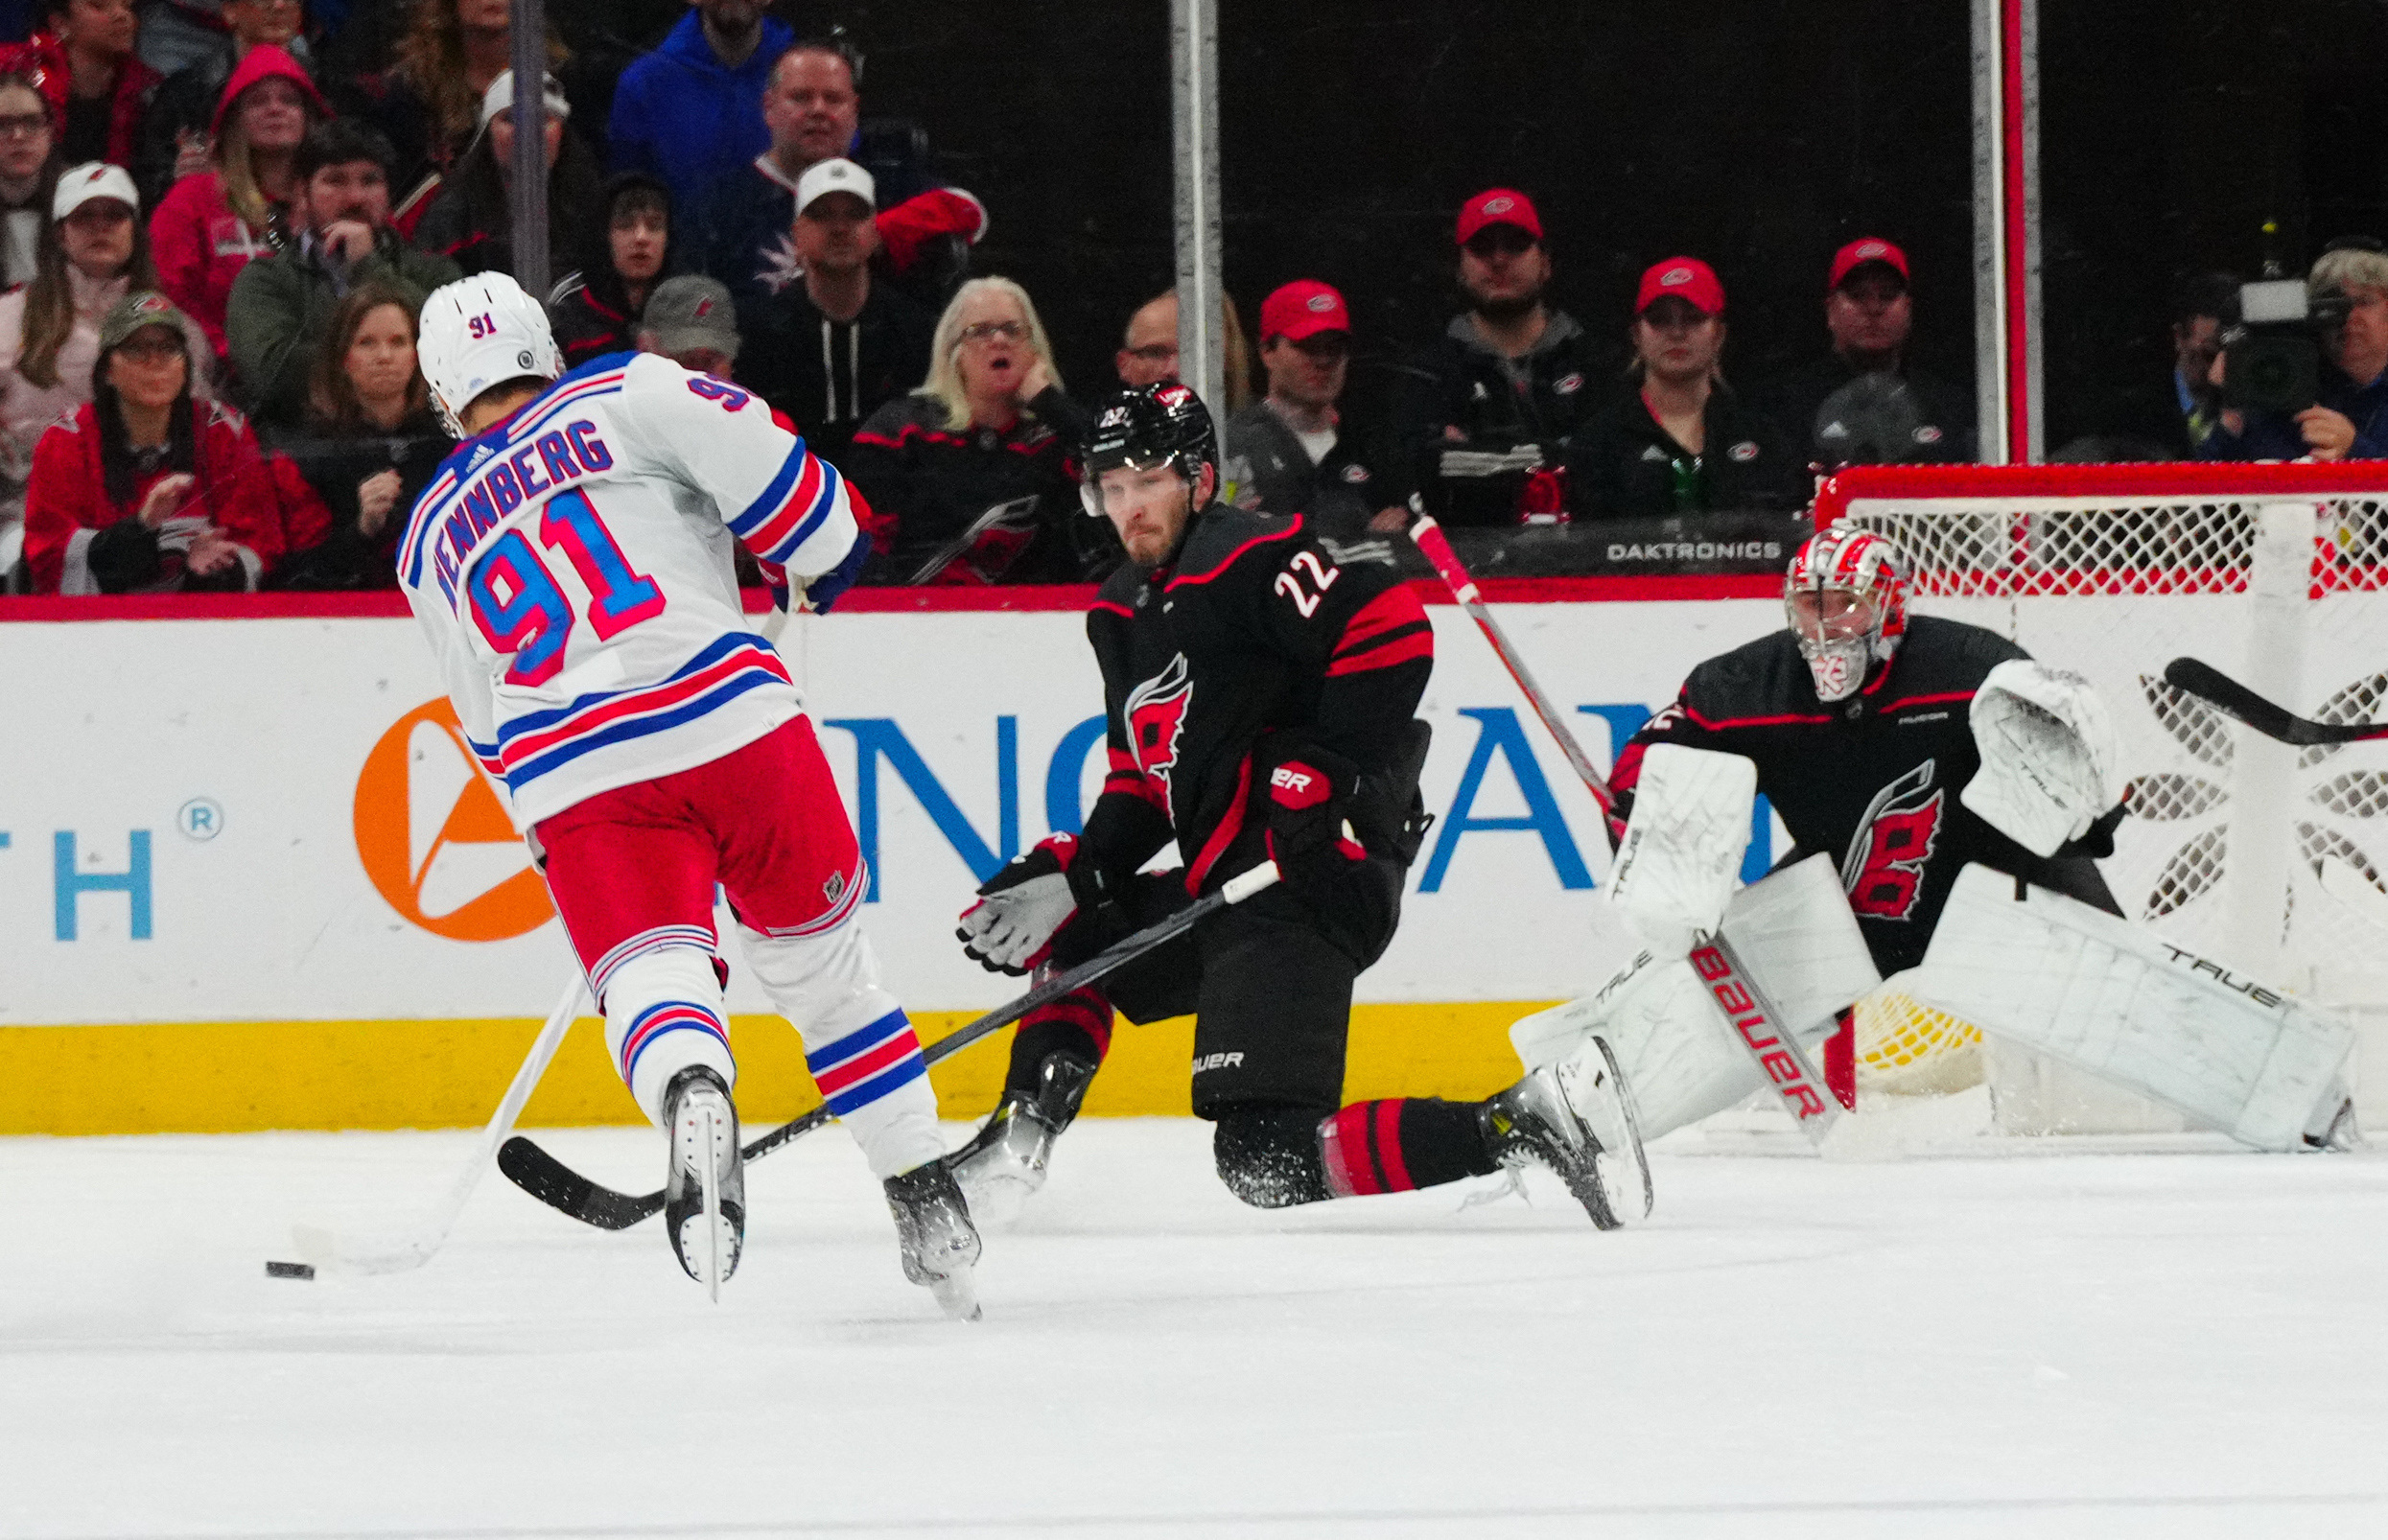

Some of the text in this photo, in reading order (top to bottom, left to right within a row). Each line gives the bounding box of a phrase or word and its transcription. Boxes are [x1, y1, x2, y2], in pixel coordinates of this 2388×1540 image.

[468, 312, 497, 338] 91
[1274, 550, 1339, 618] 22
[1606, 541, 1782, 562] DAKTRONICS
[467, 485, 666, 688] 91
[1595, 948, 1654, 1004] TRUE
[2161, 942, 2282, 1009] TRUE
[1690, 945, 1826, 1120] BAUER
